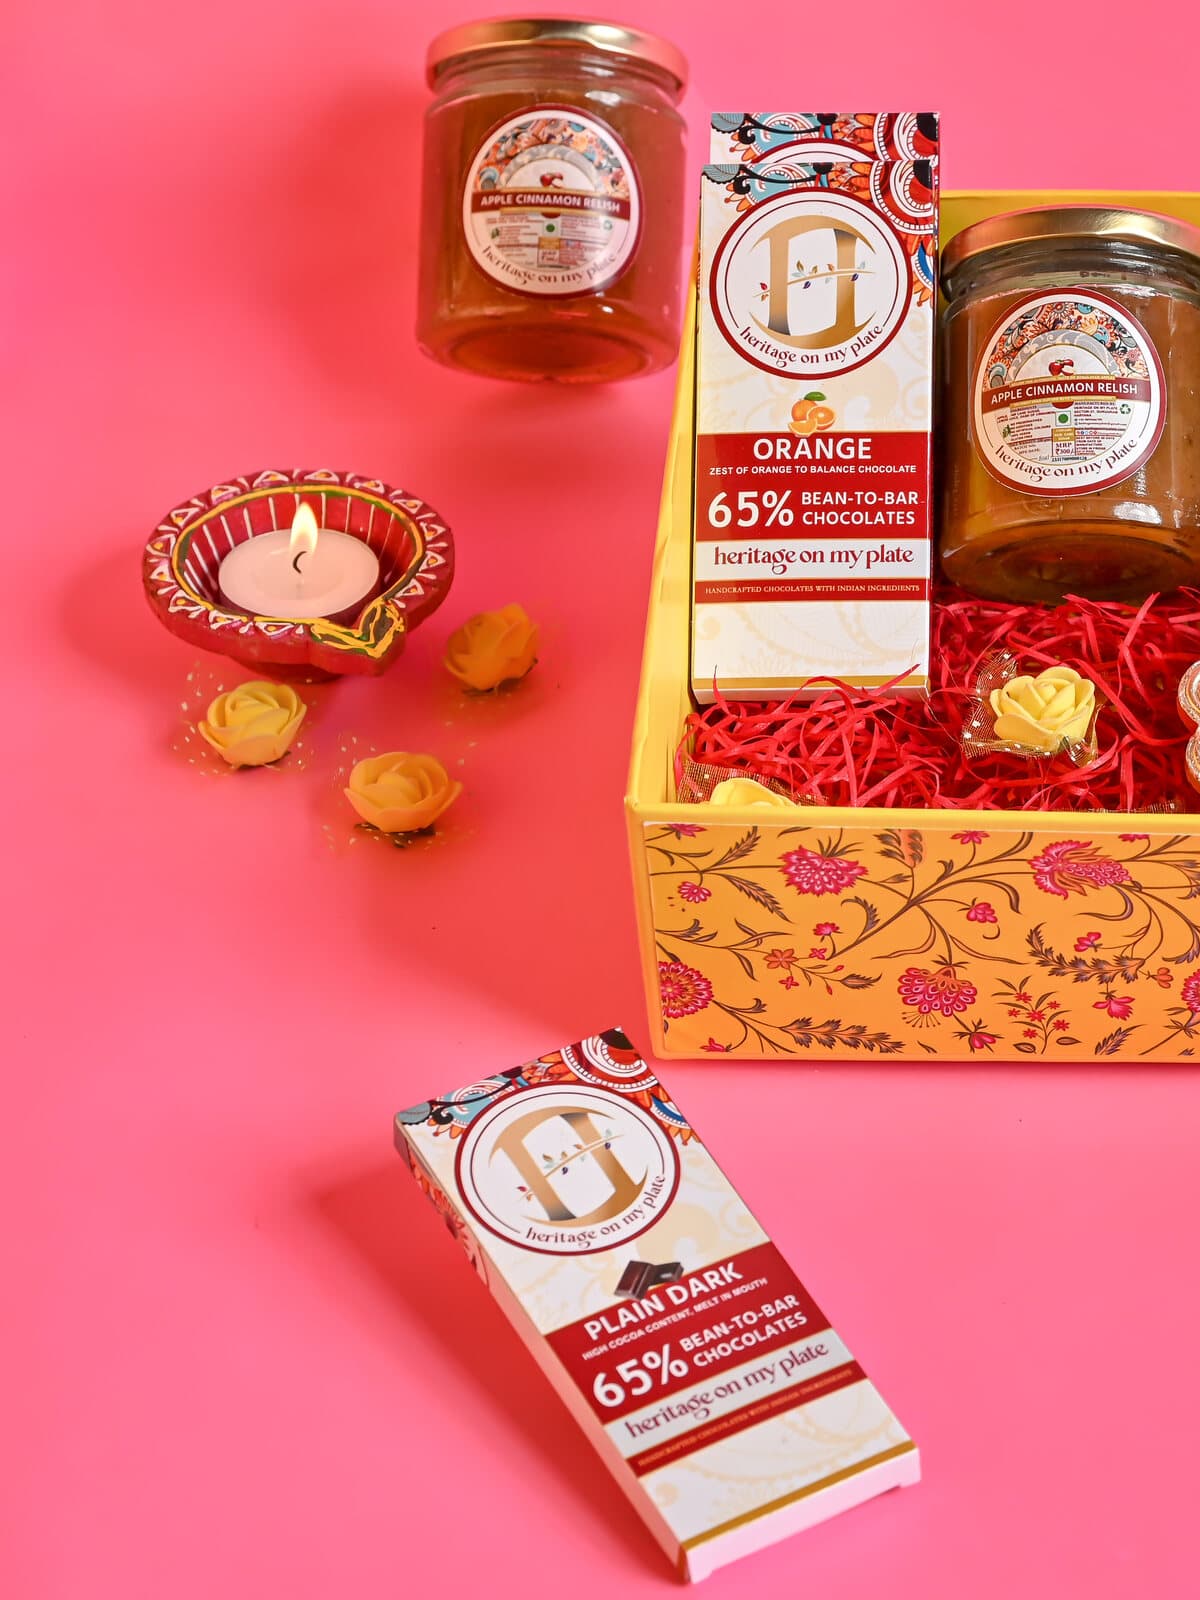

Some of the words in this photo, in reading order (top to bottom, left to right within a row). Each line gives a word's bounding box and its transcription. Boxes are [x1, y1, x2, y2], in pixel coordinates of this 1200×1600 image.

[481, 194, 512, 206] APPLE
[516, 194, 581, 206] CINNAMON
[584, 196, 620, 212] RELISH
[482, 246, 535, 285] heritage
[538, 274, 557, 282] on
[561, 271, 583, 283] my
[587, 254, 616, 280] plate
[739, 326, 796, 368] heritage
[800, 351, 820, 364] on
[824, 347, 848, 363] my
[852, 324, 883, 357] plate
[992, 390, 1022, 405] APPLE
[1026, 383, 1094, 396] CINNAMON
[1098, 383, 1138, 394] RELISH
[753, 438, 872, 460] ORANGE
[995, 445, 1051, 482] heritage
[1054, 467, 1074, 477] on
[1079, 462, 1103, 475] my
[1106, 439, 1137, 469] plate
[710, 467, 733, 475] ZEST
[736, 467, 748, 475] OF
[752, 466, 792, 474] ORANGE
[795, 466, 808, 474] TO
[810, 465, 855, 474] BALANCE
[858, 465, 916, 473] CHOCOLATE
[708, 490, 794, 527] 65%
[802, 492, 918, 505] BEAN-TO-BAR
[802, 511, 915, 525] CHOCOLATES
[714, 546, 796, 575] heritage
[800, 550, 825, 564] on
[831, 550, 864, 569] my
[865, 544, 914, 569] plate
[705, 586, 762, 594] HANDCRAFTED
[763, 585, 813, 593] CHOCOLATES
[526, 1227, 597, 1249] heritage
[600, 1222, 620, 1236] on
[622, 1208, 646, 1228] my
[644, 1175, 666, 1209] plate
[582, 1344, 607, 1361] HIGH
[608, 1331, 645, 1352] COCOA
[646, 1310, 695, 1335] CONTENT,
[694, 1296, 720, 1314] MELT
[721, 1292, 732, 1303] IN
[732, 1277, 768, 1298] MOUTH
[583, 1298, 664, 1341] PLAIN
[668, 1262, 744, 1306] DARK
[679, 1294, 800, 1353] BEAN-TO-BAR
[693, 1312, 808, 1367] CHOCOLATES
[592, 1344, 689, 1408] 65%
[624, 1390, 713, 1438] heritage
[713, 1380, 743, 1399] on
[745, 1362, 778, 1386] my
[778, 1340, 829, 1377] plate
